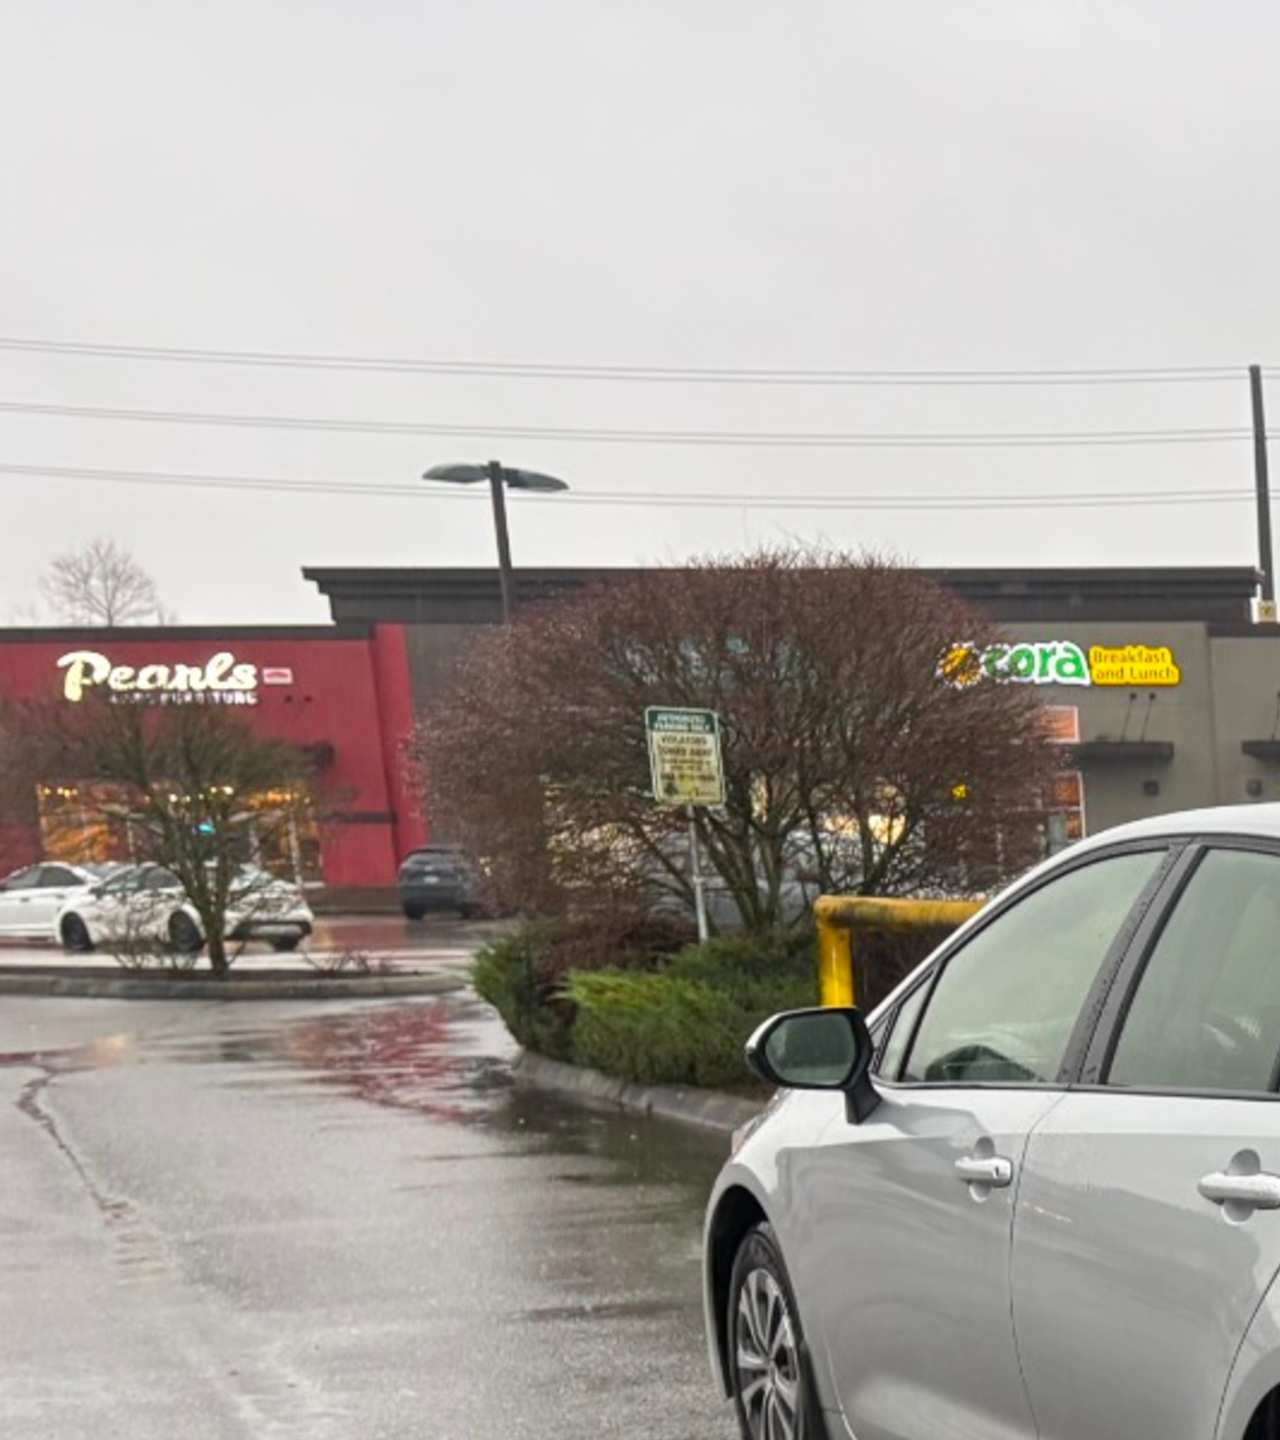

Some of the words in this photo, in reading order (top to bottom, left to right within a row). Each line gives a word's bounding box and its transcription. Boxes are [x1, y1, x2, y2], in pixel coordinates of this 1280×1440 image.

[983, 646, 1087, 679] cora
[1093, 648, 1167, 664] Breakfast
[57, 651, 258, 702] Pearls
[1096, 665, 1124, 680] and
[1128, 666, 1175, 680] Lunch
